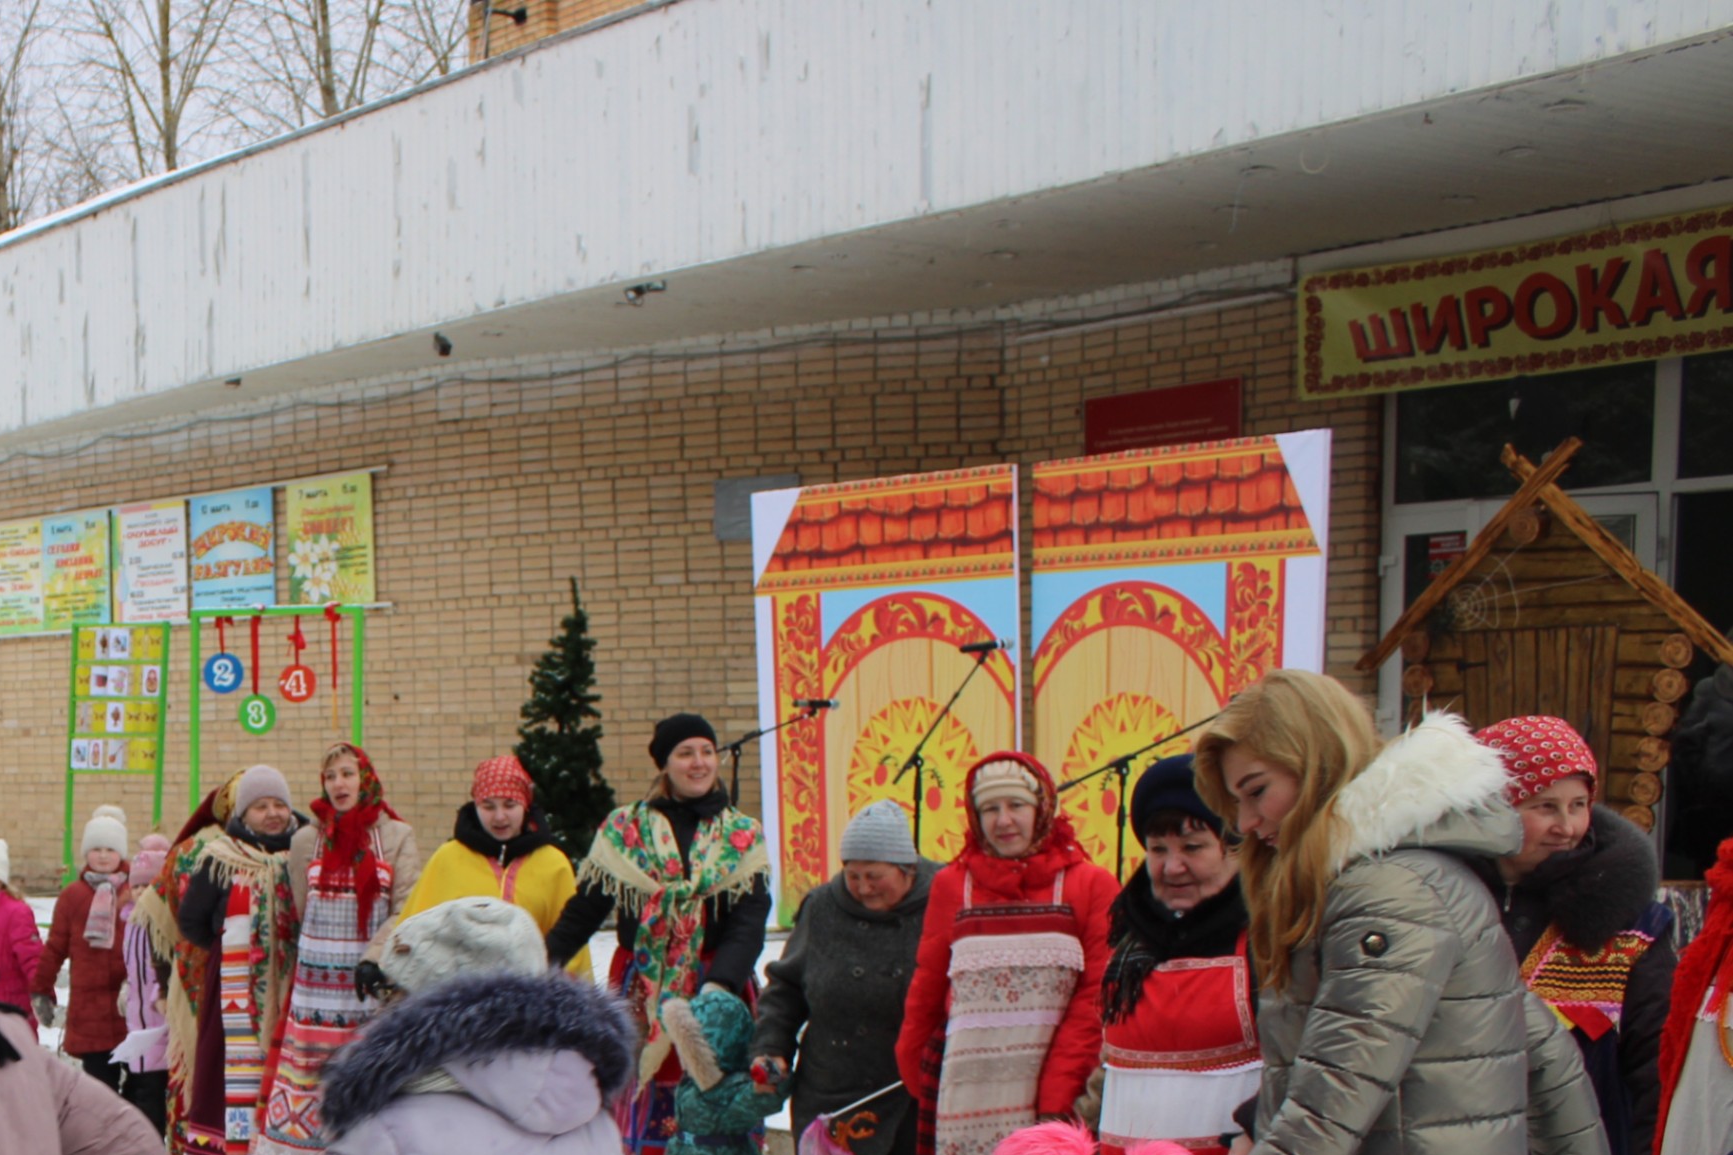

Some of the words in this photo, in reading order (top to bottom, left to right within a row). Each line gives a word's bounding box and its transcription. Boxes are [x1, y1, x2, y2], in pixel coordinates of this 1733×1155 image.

[1349, 235, 1733, 362] ШИРОКАЯ
[212, 659, 235, 687] 2
[284, 669, 307, 697] 4
[247, 700, 267, 728] 3
